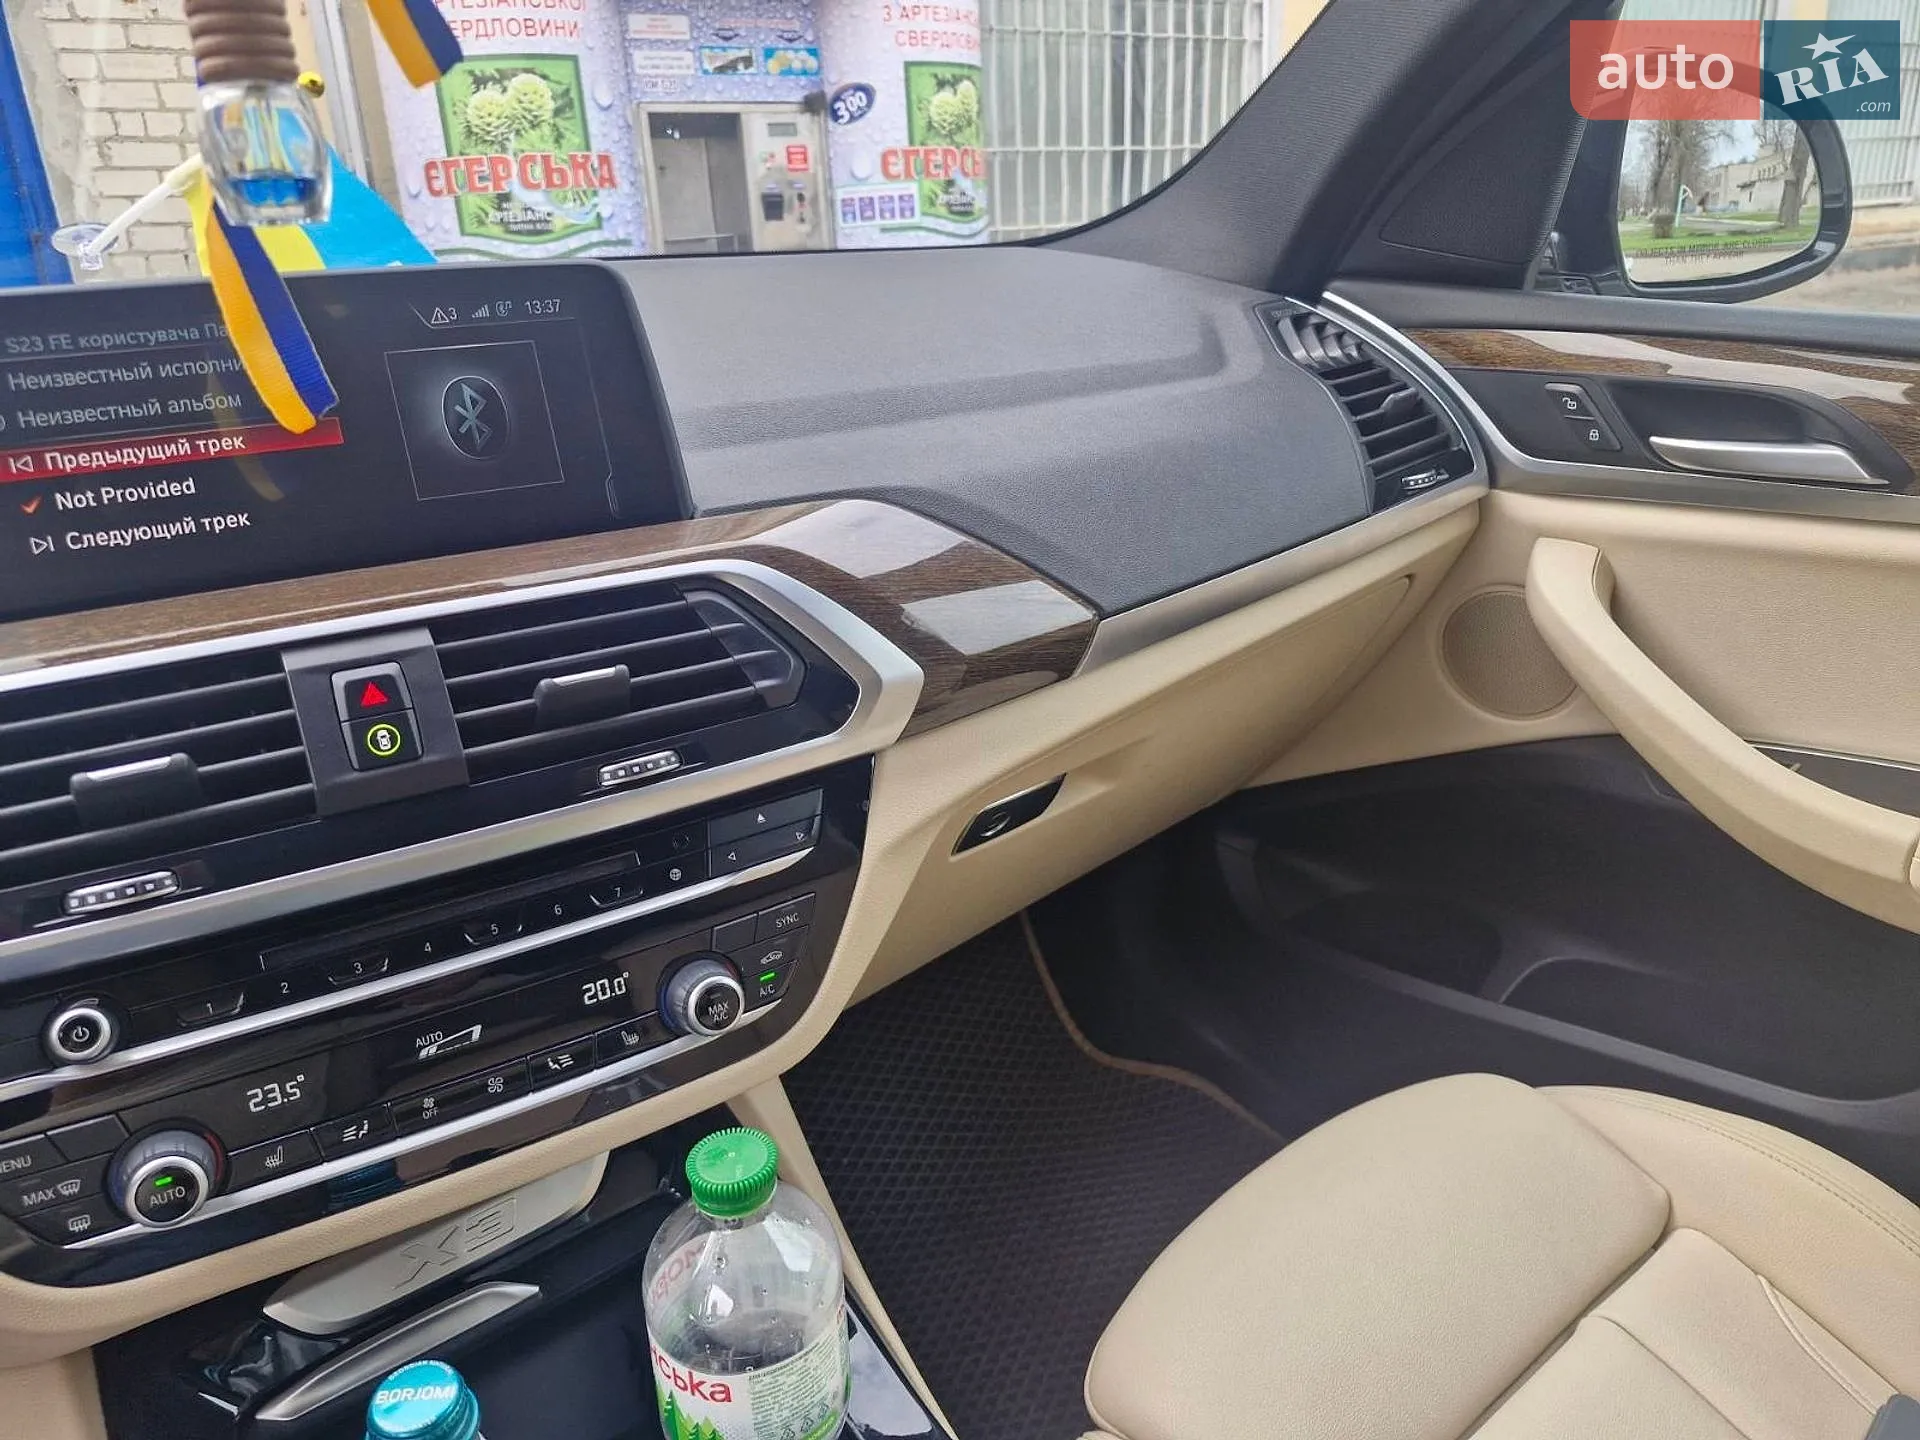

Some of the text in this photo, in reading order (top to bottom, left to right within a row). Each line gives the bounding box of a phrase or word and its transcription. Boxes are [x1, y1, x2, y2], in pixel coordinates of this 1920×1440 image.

[448, 17, 581, 40] ЕРДЛОВИНИ
[423, 151, 618, 198] ЄГЕРСЬКА
[448, 307, 458, 321] 3
[524, 299, 561, 315] 13:37
[4, 322, 227, 353] S23 FE користувача Па
[8, 357, 243, 392] Неизвестный исполни
[17, 393, 242, 429] Неизвестный альбом
[44, 435, 246, 473] Предыдущий трек
[54, 477, 196, 511] Not Provided
[66, 512, 250, 551] Следующий трек
[614, 887, 623, 899] 7
[554, 904, 563, 916] 6
[775, 912, 800, 928] SYNC
[490, 922, 499, 936] 5
[424, 941, 432, 954] 4
[353, 961, 363, 975] 3
[280, 982, 289, 994] 2
[759, 983, 776, 998] A/C
[207, 1002, 213, 1014] 1
[708, 1001, 730, 1016] MAX
[713, 1011, 729, 1022] A/C
[415, 1031, 444, 1048] AUTO
[422, 1106, 440, 1119] OFF
[0, 1155, 32, 1174] ENU
[23, 1187, 55, 1207] MAX
[149, 1186, 186, 1208] AUTO
[391, 1197, 517, 1291] X3
[374, 1382, 459, 1406] BORJOMI
